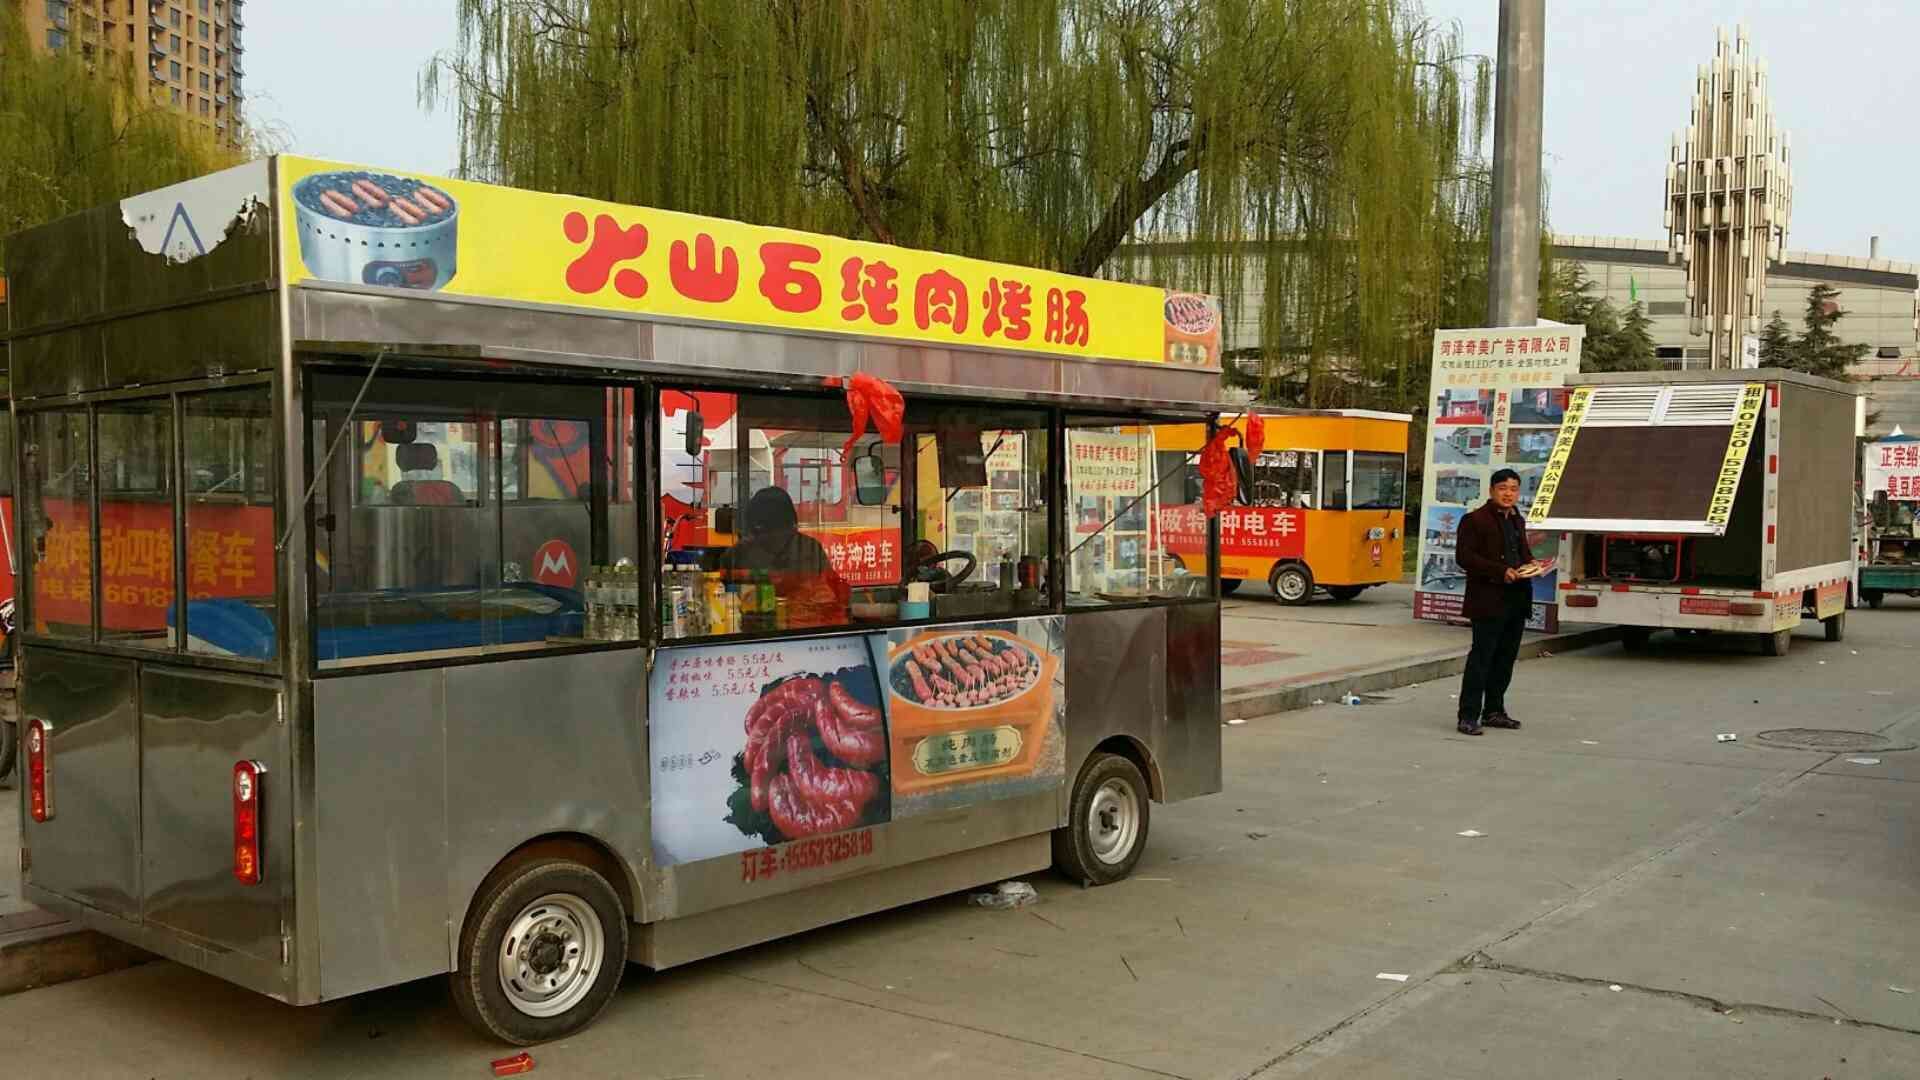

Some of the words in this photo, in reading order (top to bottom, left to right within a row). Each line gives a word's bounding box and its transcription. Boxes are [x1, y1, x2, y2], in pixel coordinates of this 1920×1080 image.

[562, 210, 1090, 348] 火山石纯肉烤肠
